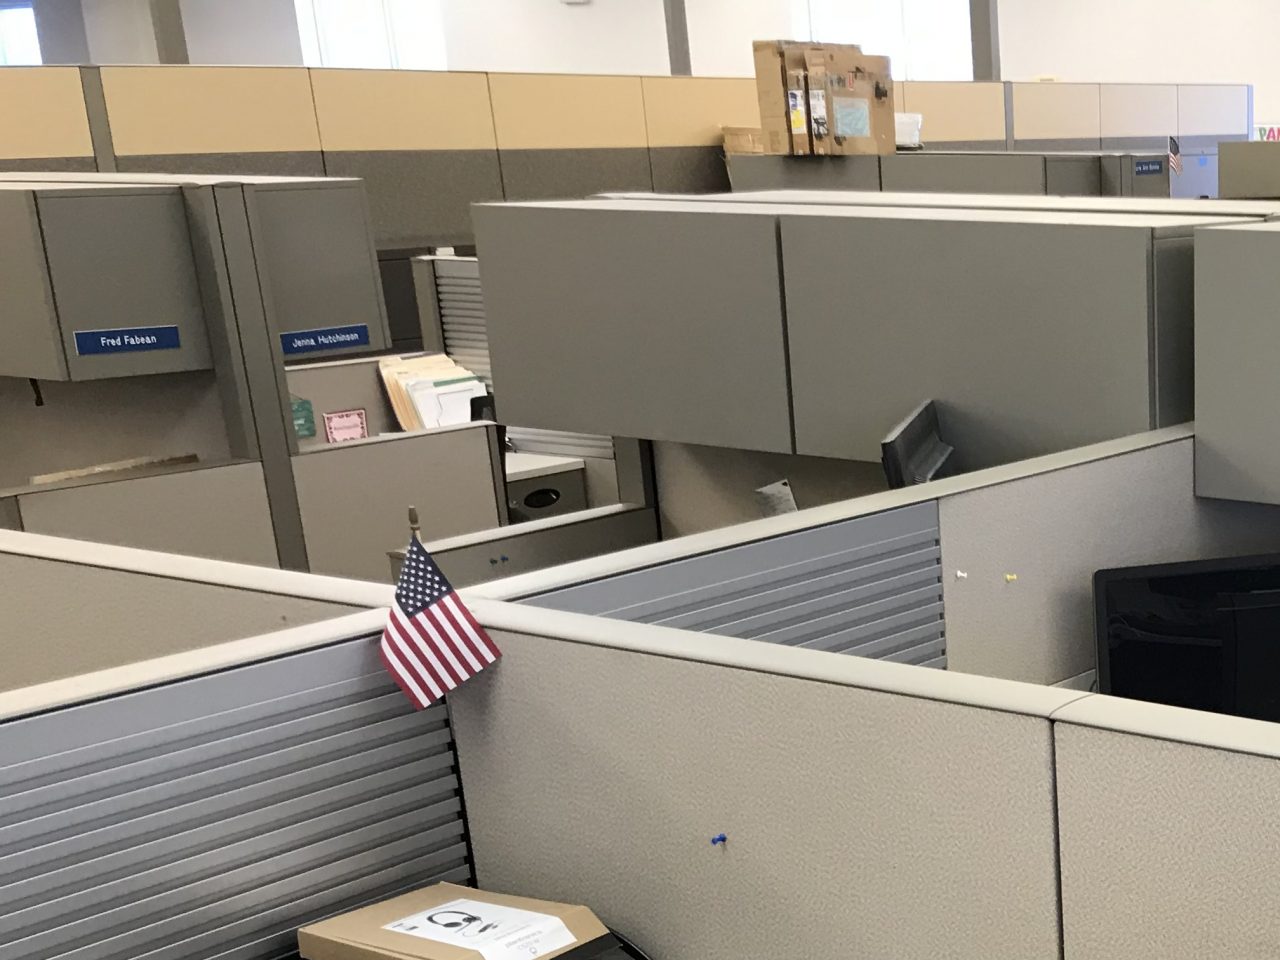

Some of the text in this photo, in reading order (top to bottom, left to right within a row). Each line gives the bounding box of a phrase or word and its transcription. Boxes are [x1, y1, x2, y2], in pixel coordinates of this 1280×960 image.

[100, 335, 157, 347] Fred Fabean
[292, 332, 359, 348] Jenna Hutchinson
